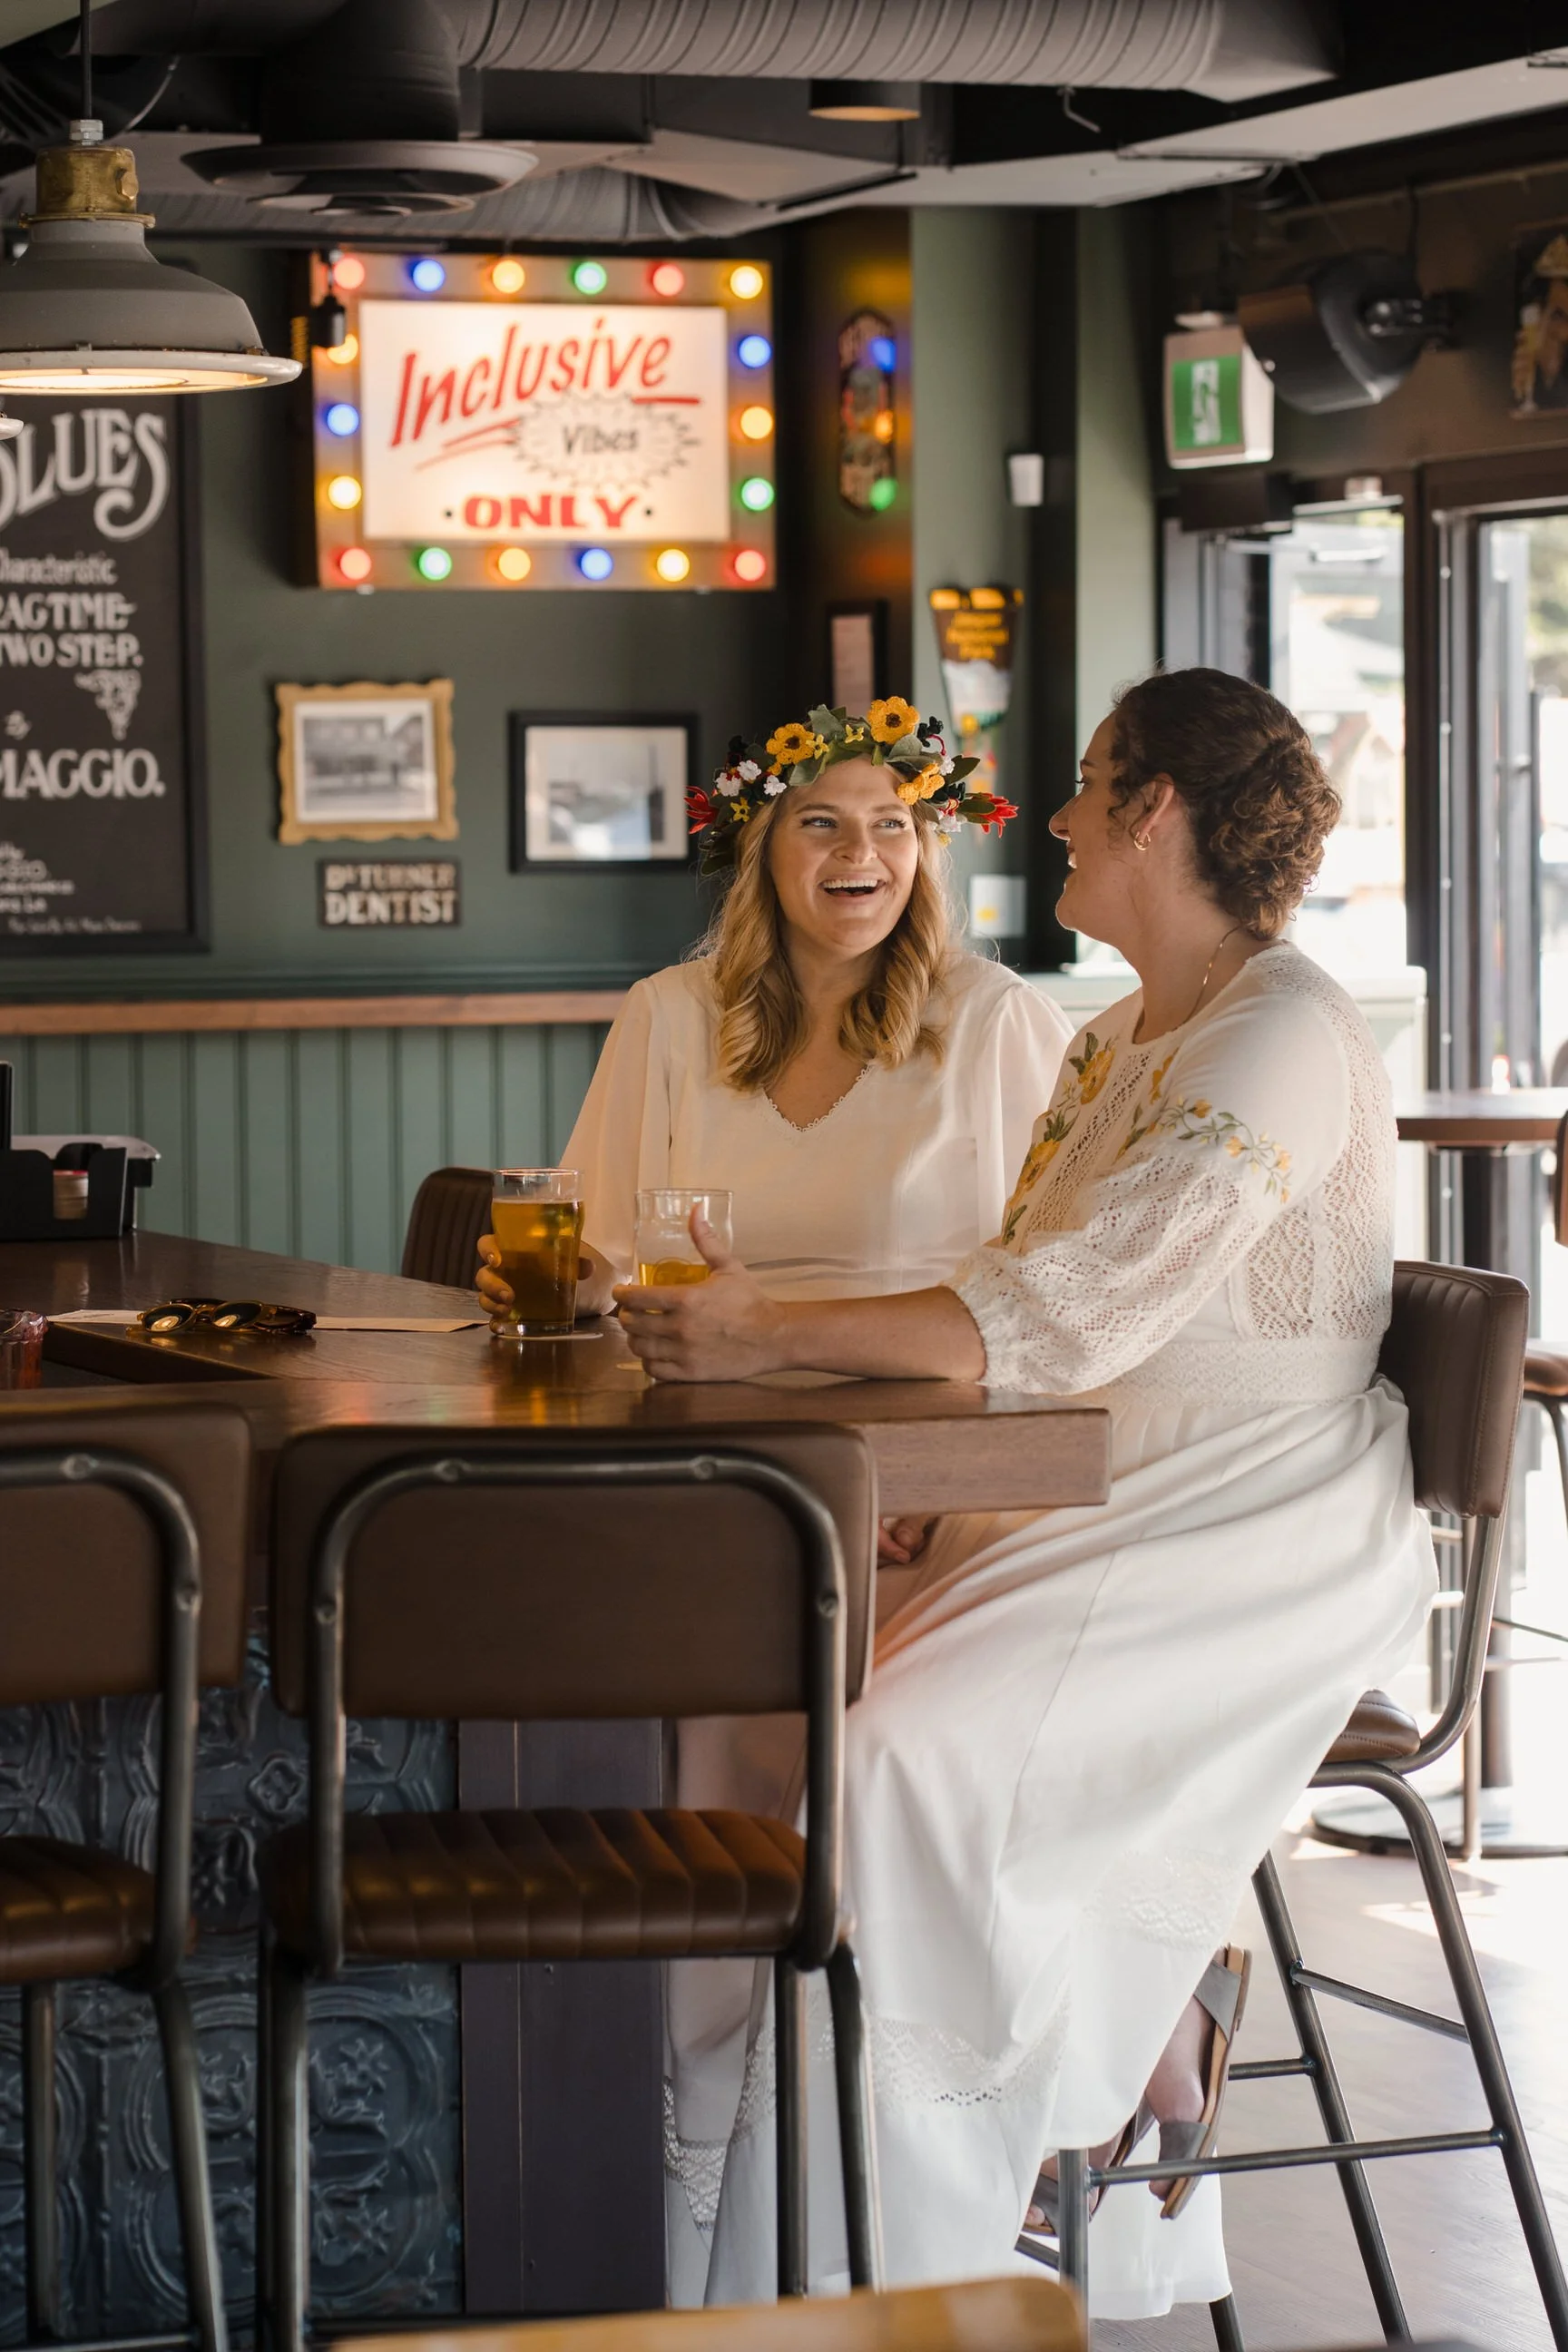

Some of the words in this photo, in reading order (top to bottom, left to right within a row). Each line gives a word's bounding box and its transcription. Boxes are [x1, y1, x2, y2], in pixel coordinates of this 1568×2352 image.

[391, 317, 671, 448] Inclusive
[563, 423, 641, 454] Vibes
[464, 494, 639, 529] ONLY
[0, 546, 118, 585] haracteristic
[0, 592, 137, 630] AGTIME
[325, 890, 458, 925] DENTIST
